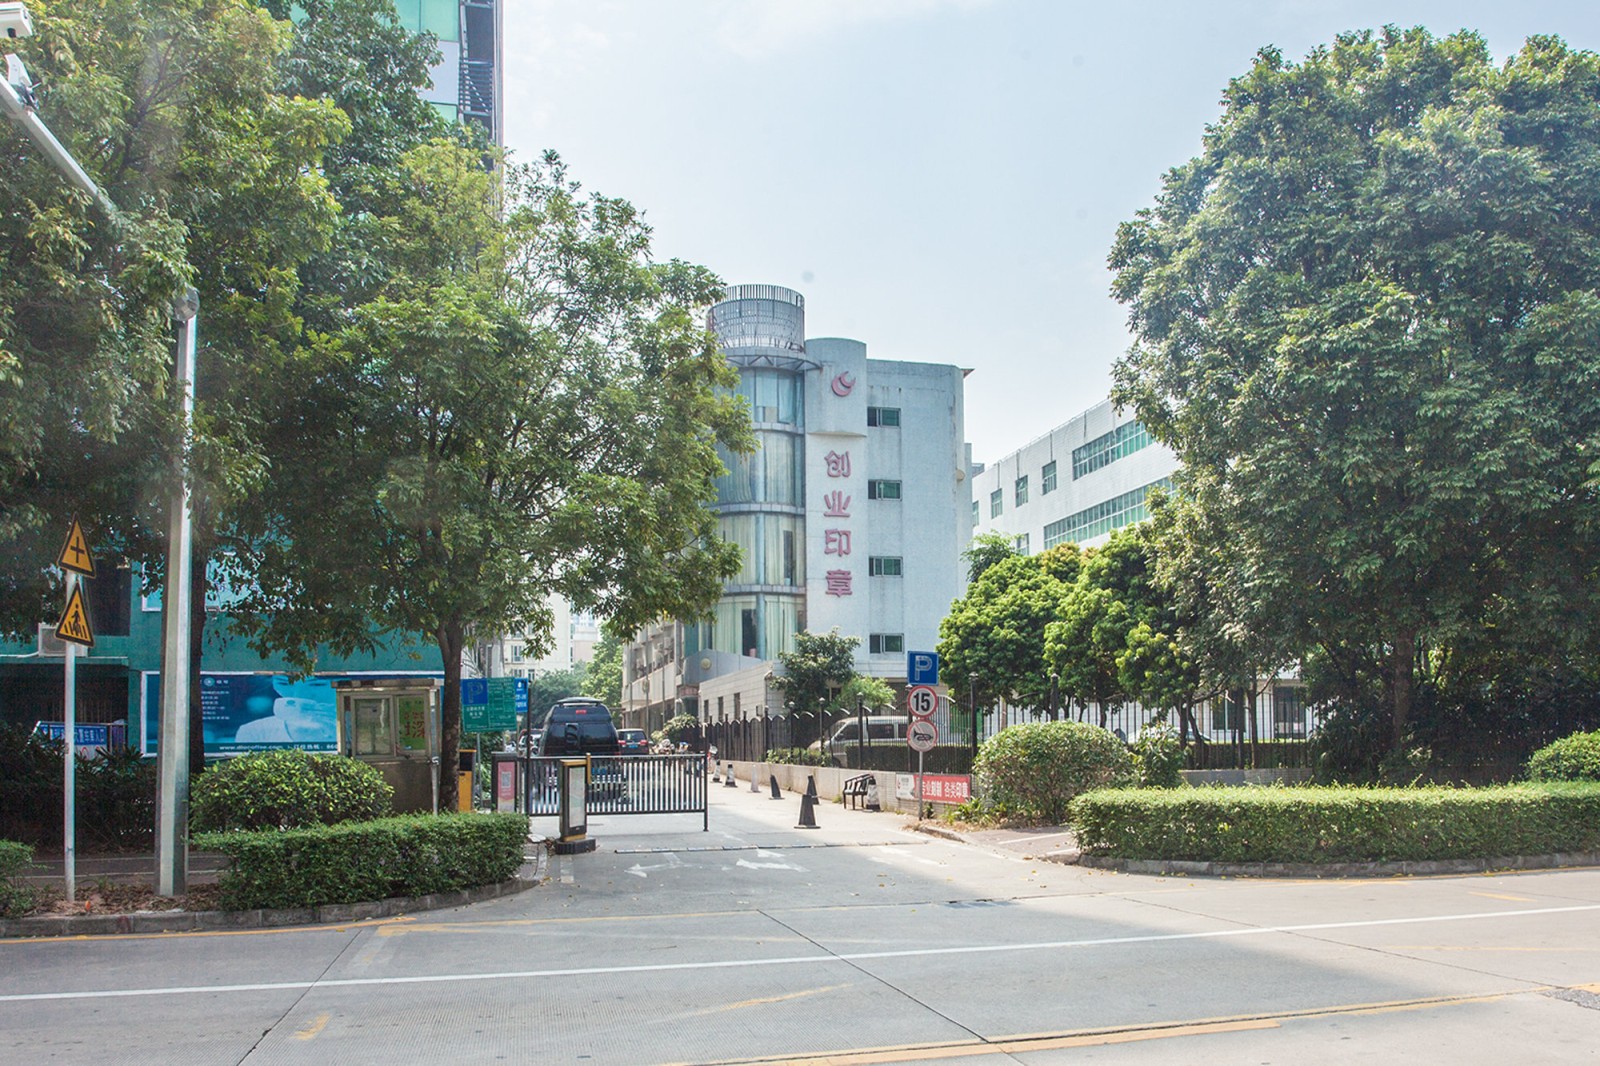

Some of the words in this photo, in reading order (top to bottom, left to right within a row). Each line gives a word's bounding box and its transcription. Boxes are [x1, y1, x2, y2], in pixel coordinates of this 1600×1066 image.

[823, 449, 853, 598] 创业印章
[914, 655, 933, 681] P
[913, 692, 931, 712] 15
